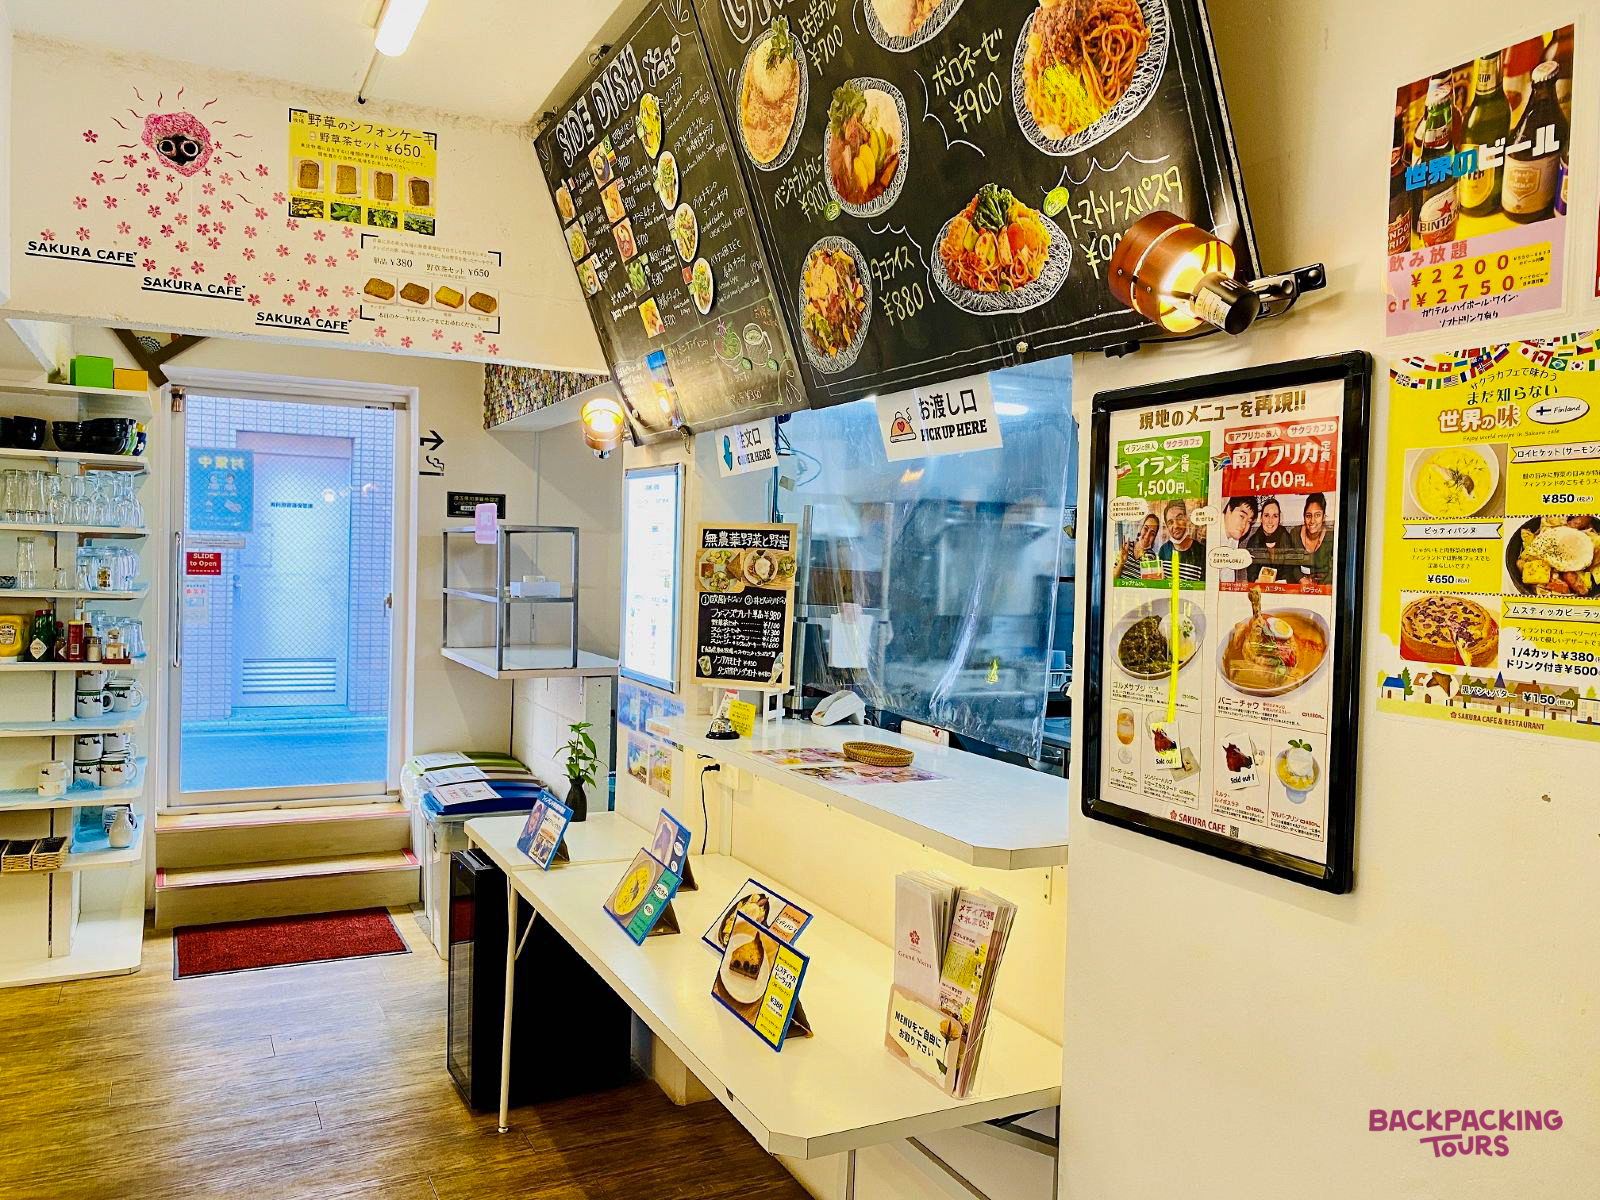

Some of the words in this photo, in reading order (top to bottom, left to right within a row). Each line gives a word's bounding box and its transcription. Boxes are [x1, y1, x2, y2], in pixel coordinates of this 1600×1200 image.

[807, 24, 843, 76] ¥700
[932, 27, 1003, 96] ボロネーゼ
[556, 95, 595, 168] SIDE
[591, 43, 643, 130] DISH
[950, 71, 1002, 133] ¥900
[308, 113, 434, 145] 野草のシフォンケーキ
[319, 132, 380, 149] 野草茶セット
[386, 143, 421, 158] ¥650
[1405, 124, 1560, 192] 世界のビール
[774, 153, 823, 210] ベジタブルカレー
[1066, 164, 1184, 239] トマトソースパスタ
[28, 240, 91, 257] SAKURA
[97, 249, 134, 263] CAFE
[871, 245, 916, 280] タコライス
[1388, 240, 1468, 272] 飲み放題
[143, 276, 202, 292] SAKURA
[207, 284, 242, 297] CAFE
[879, 282, 925, 326] ¥880
[1388, 298, 1410, 313] or
[256, 311, 311, 327] SAKURA
[316, 318, 348, 331] CAFE
[1439, 310, 1499, 328] ソフトドリンク有り
[1470, 367, 1557, 390] サクラカフェで味わう
[918, 389, 978, 421] お渡し口
[1467, 384, 1558, 406] まだ知らない
[1139, 390, 1307, 430] 現地のメニューを再現!!
[1438, 403, 1521, 434] 世界の味
[957, 419, 988, 437] HERE
[1290, 423, 1335, 436] サクラカフェ
[755, 448, 772, 462] HERE
[1165, 438, 1202, 450] サクラカフェ
[1137, 455, 1182, 477] イラン
[1233, 441, 1318, 470] 南アフリカ
[1137, 478, 1185, 498] 1,500円
[1248, 470, 1306, 491] 1,700円
[1542, 493, 1575, 503] ¥850
[704, 530, 789, 550] 無農薬野菜と野草
[198, 560, 217, 568] Open
[1427, 574, 1455, 584] ¥650
[1218, 696, 1260, 710] バニーチャウ
[1523, 692, 1555, 705] ¥150
[1458, 712, 1481, 723] SAKURA
[1483, 716, 1497, 725] CAFE
[1498, 717, 1503, 725] &
[1503, 718, 1545, 731] RESTAURANT
[1179, 813, 1206, 829] SAKURA
[1208, 821, 1226, 833] CAFE
[894, 1010, 942, 1048] MENUをご自由に
[899, 1028, 934, 1057] お取り下さい
